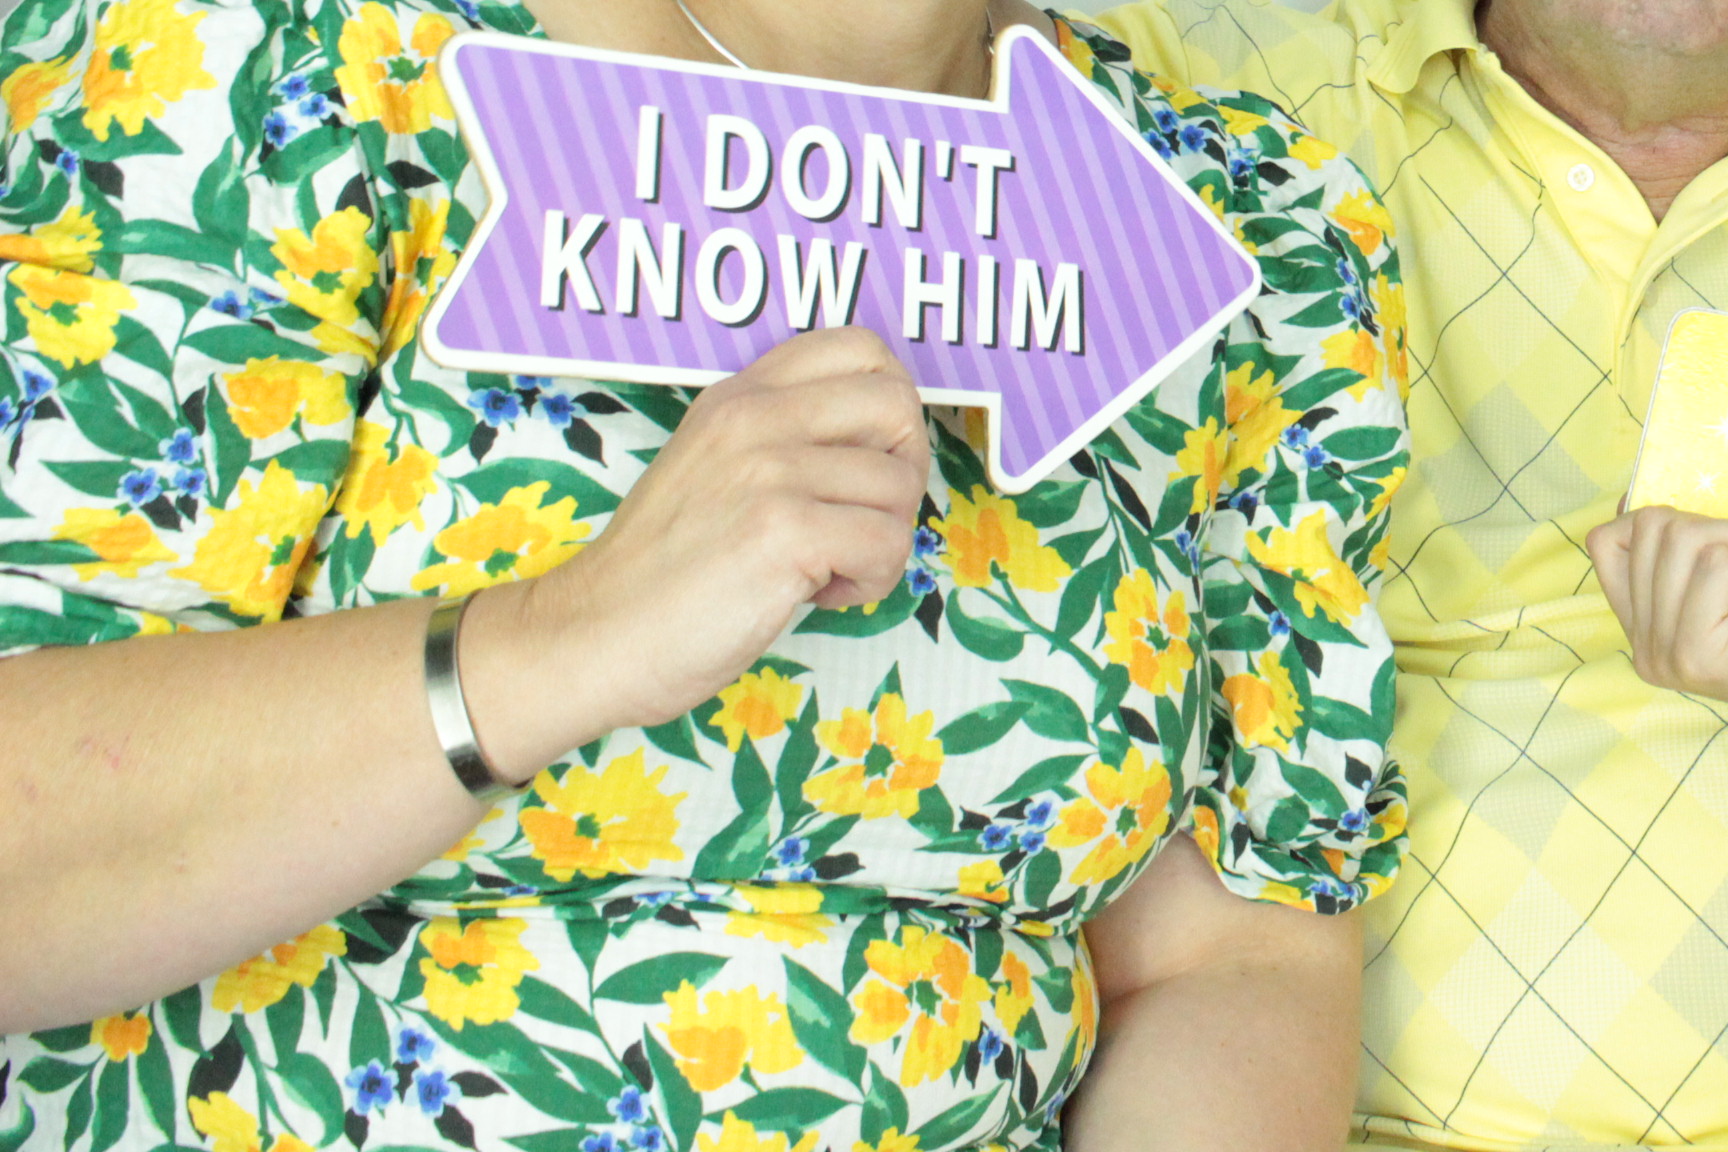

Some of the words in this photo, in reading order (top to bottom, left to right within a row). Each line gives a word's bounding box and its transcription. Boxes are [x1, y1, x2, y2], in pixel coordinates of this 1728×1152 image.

[634, 104, 662, 202] I
[702, 113, 1014, 239] DON'T
[539, 208, 867, 332] KNOW
[901, 247, 1085, 355] HIM
